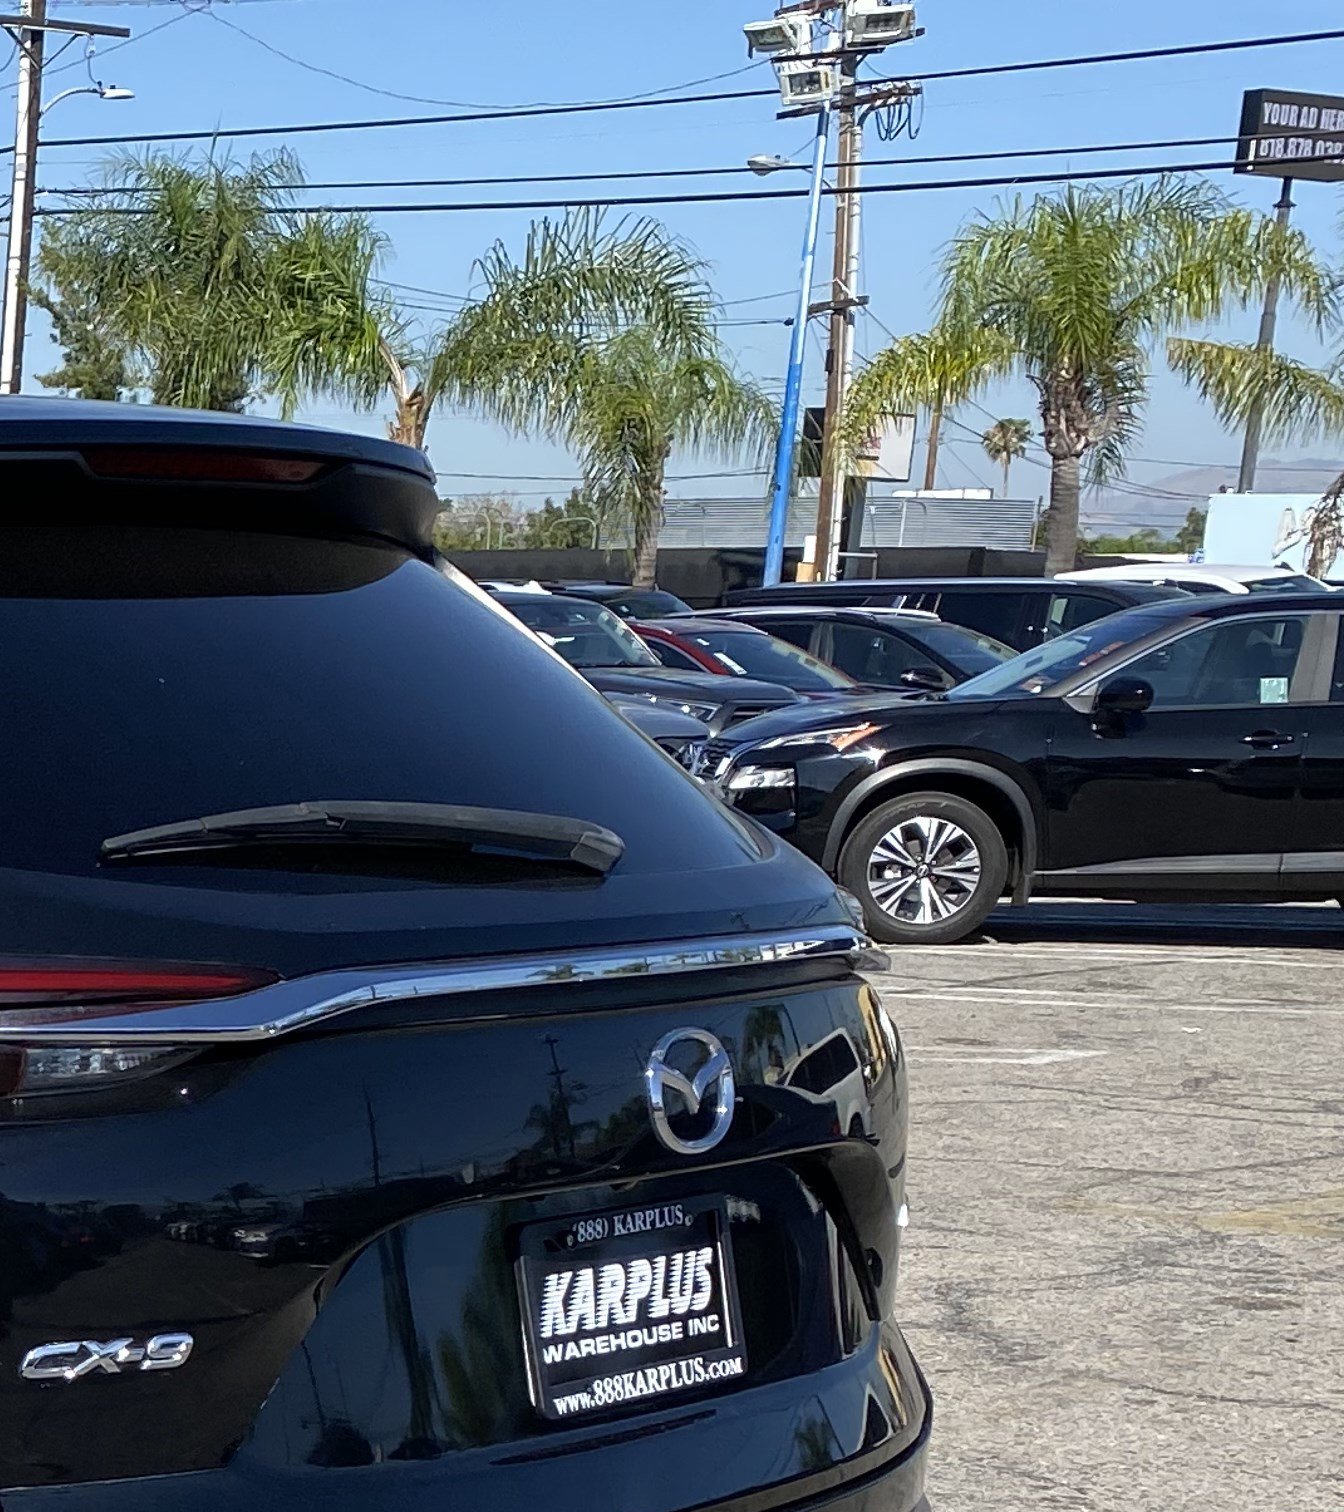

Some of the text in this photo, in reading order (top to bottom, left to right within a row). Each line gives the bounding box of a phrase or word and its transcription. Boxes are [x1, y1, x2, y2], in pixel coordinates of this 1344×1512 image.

[1263, 102, 1299, 127] YOUR
[1299, 106, 1318, 129] AD
[613, 1205, 683, 1236] KARPLUS
[539, 1246, 713, 1338] KARPLUS
[21, 1332, 194, 1382] CX-9
[543, 1314, 720, 1364] WAREHOUSE INC
